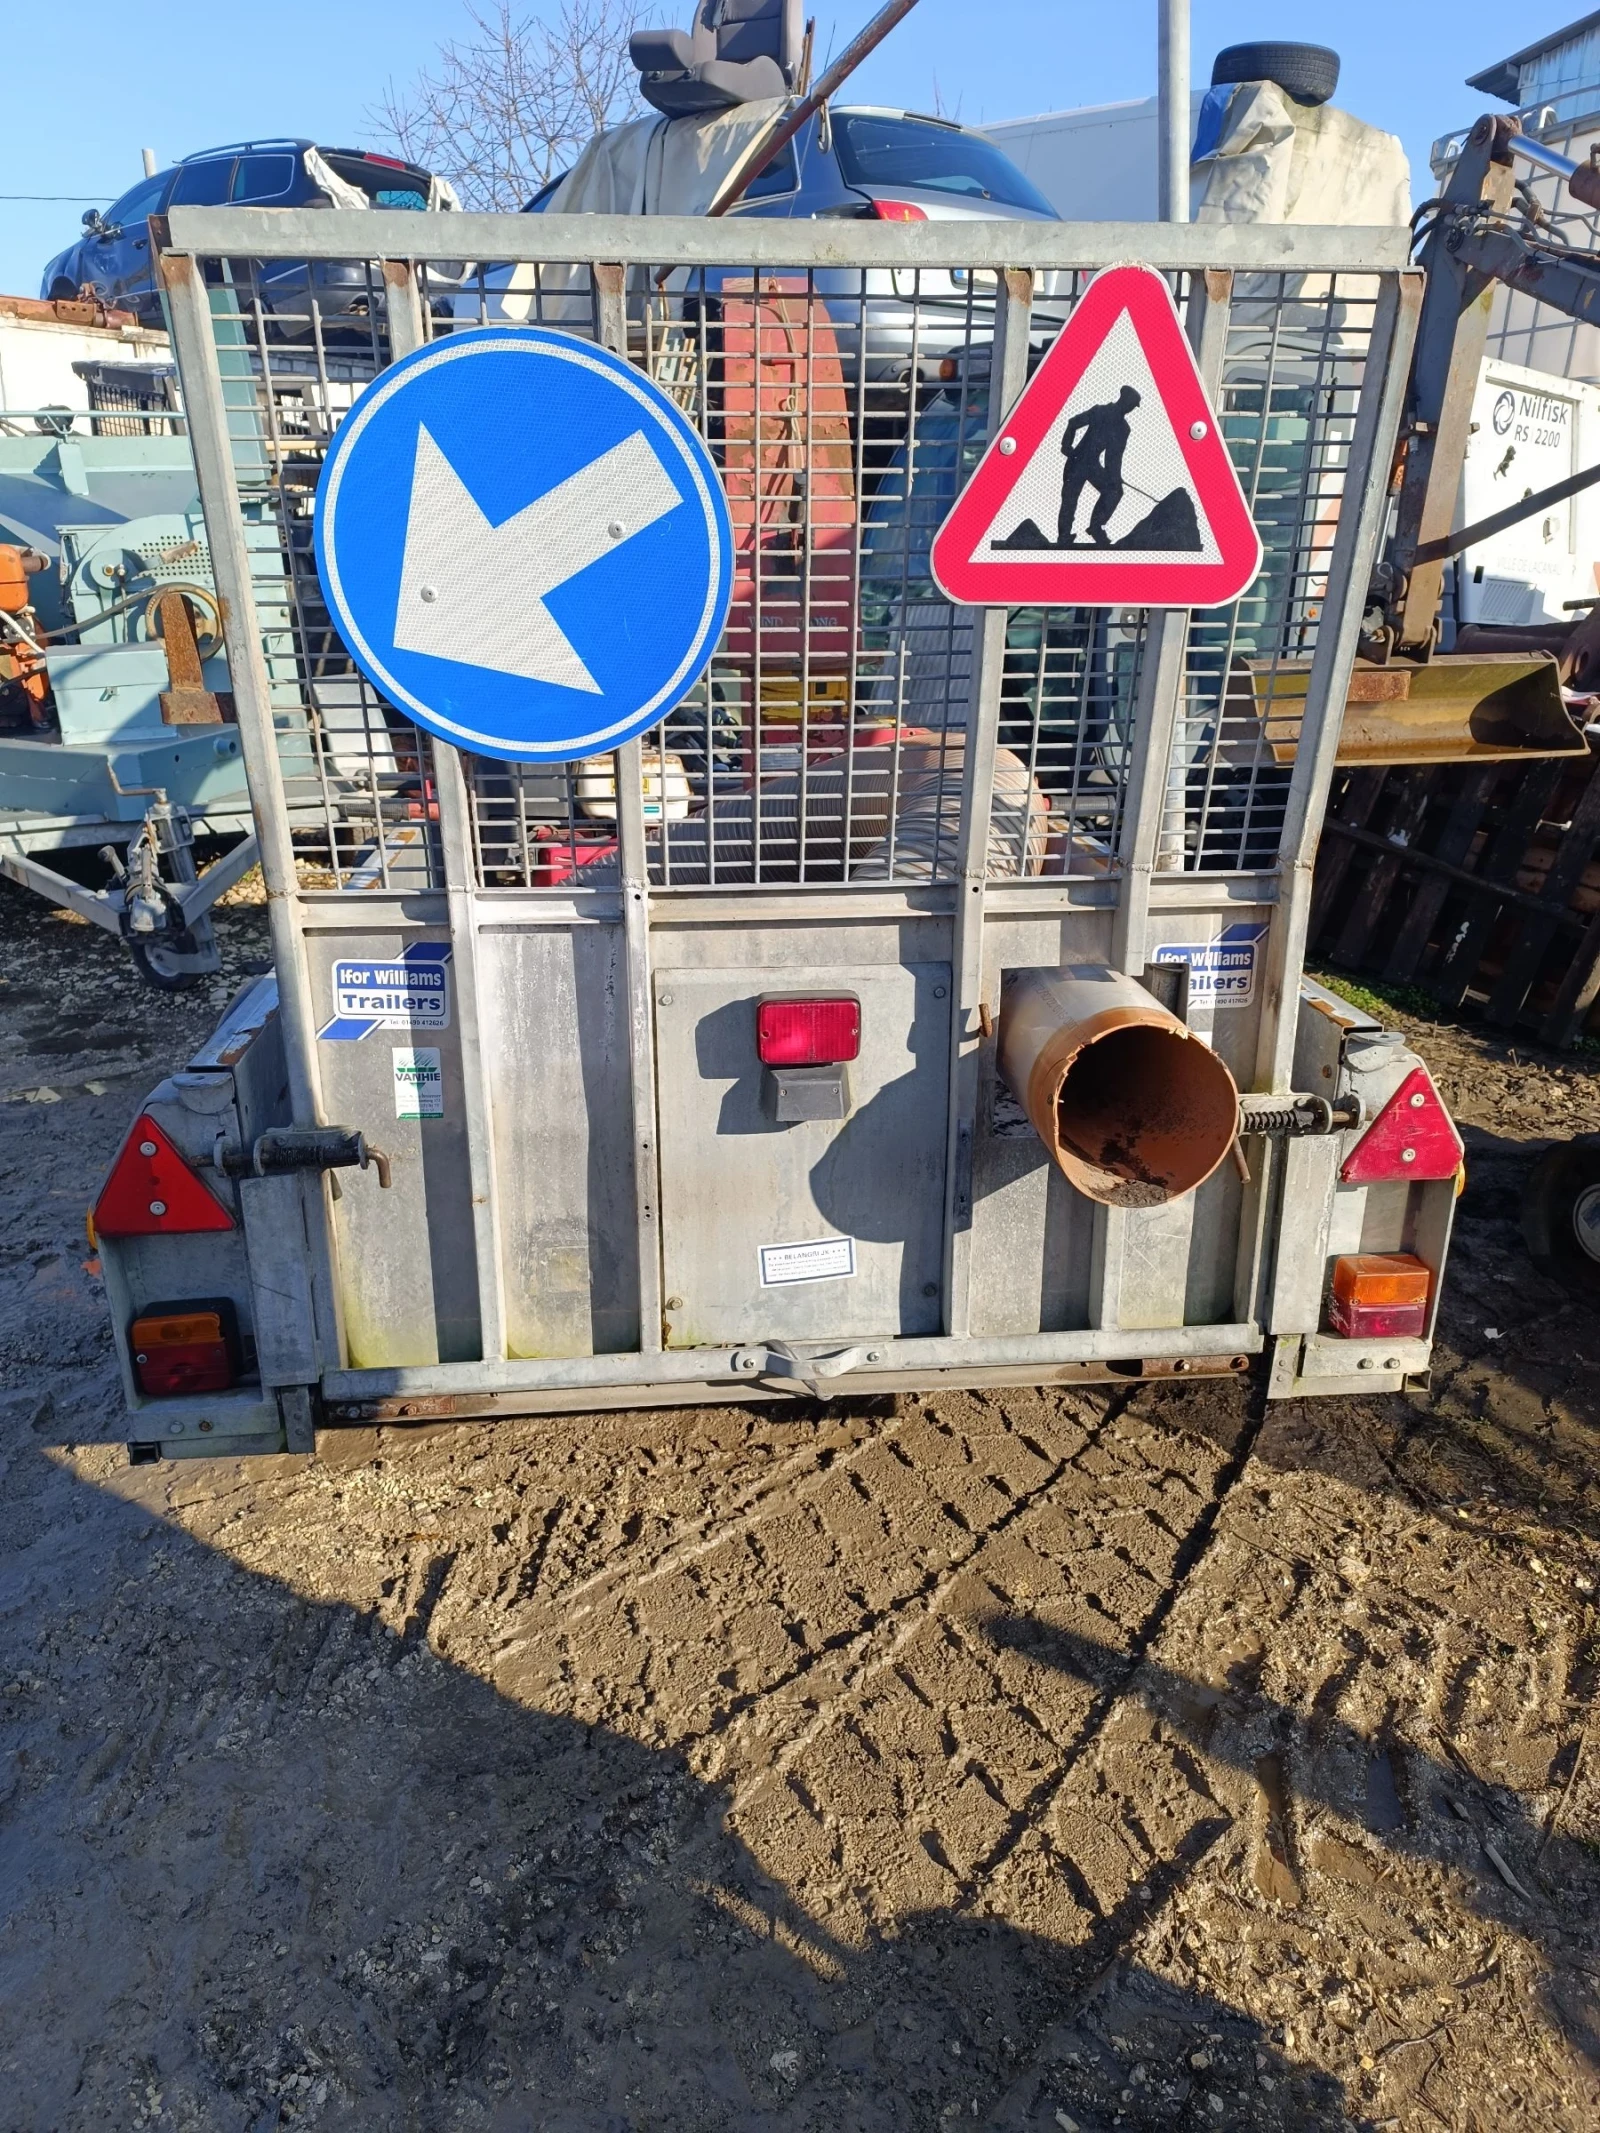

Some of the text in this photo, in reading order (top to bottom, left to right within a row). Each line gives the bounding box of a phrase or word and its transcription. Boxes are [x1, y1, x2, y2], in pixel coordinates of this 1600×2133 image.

[1519, 395, 1569, 425] Nilfisk
[1514, 424, 1561, 448] RS 2200
[1191, 952, 1251, 966] Williams
[341, 968, 442, 987] Ifor Williams
[1190, 976, 1247, 990] ailers
[342, 994, 441, 1010] Trailers
[395, 1072, 441, 1082] VANHIE
